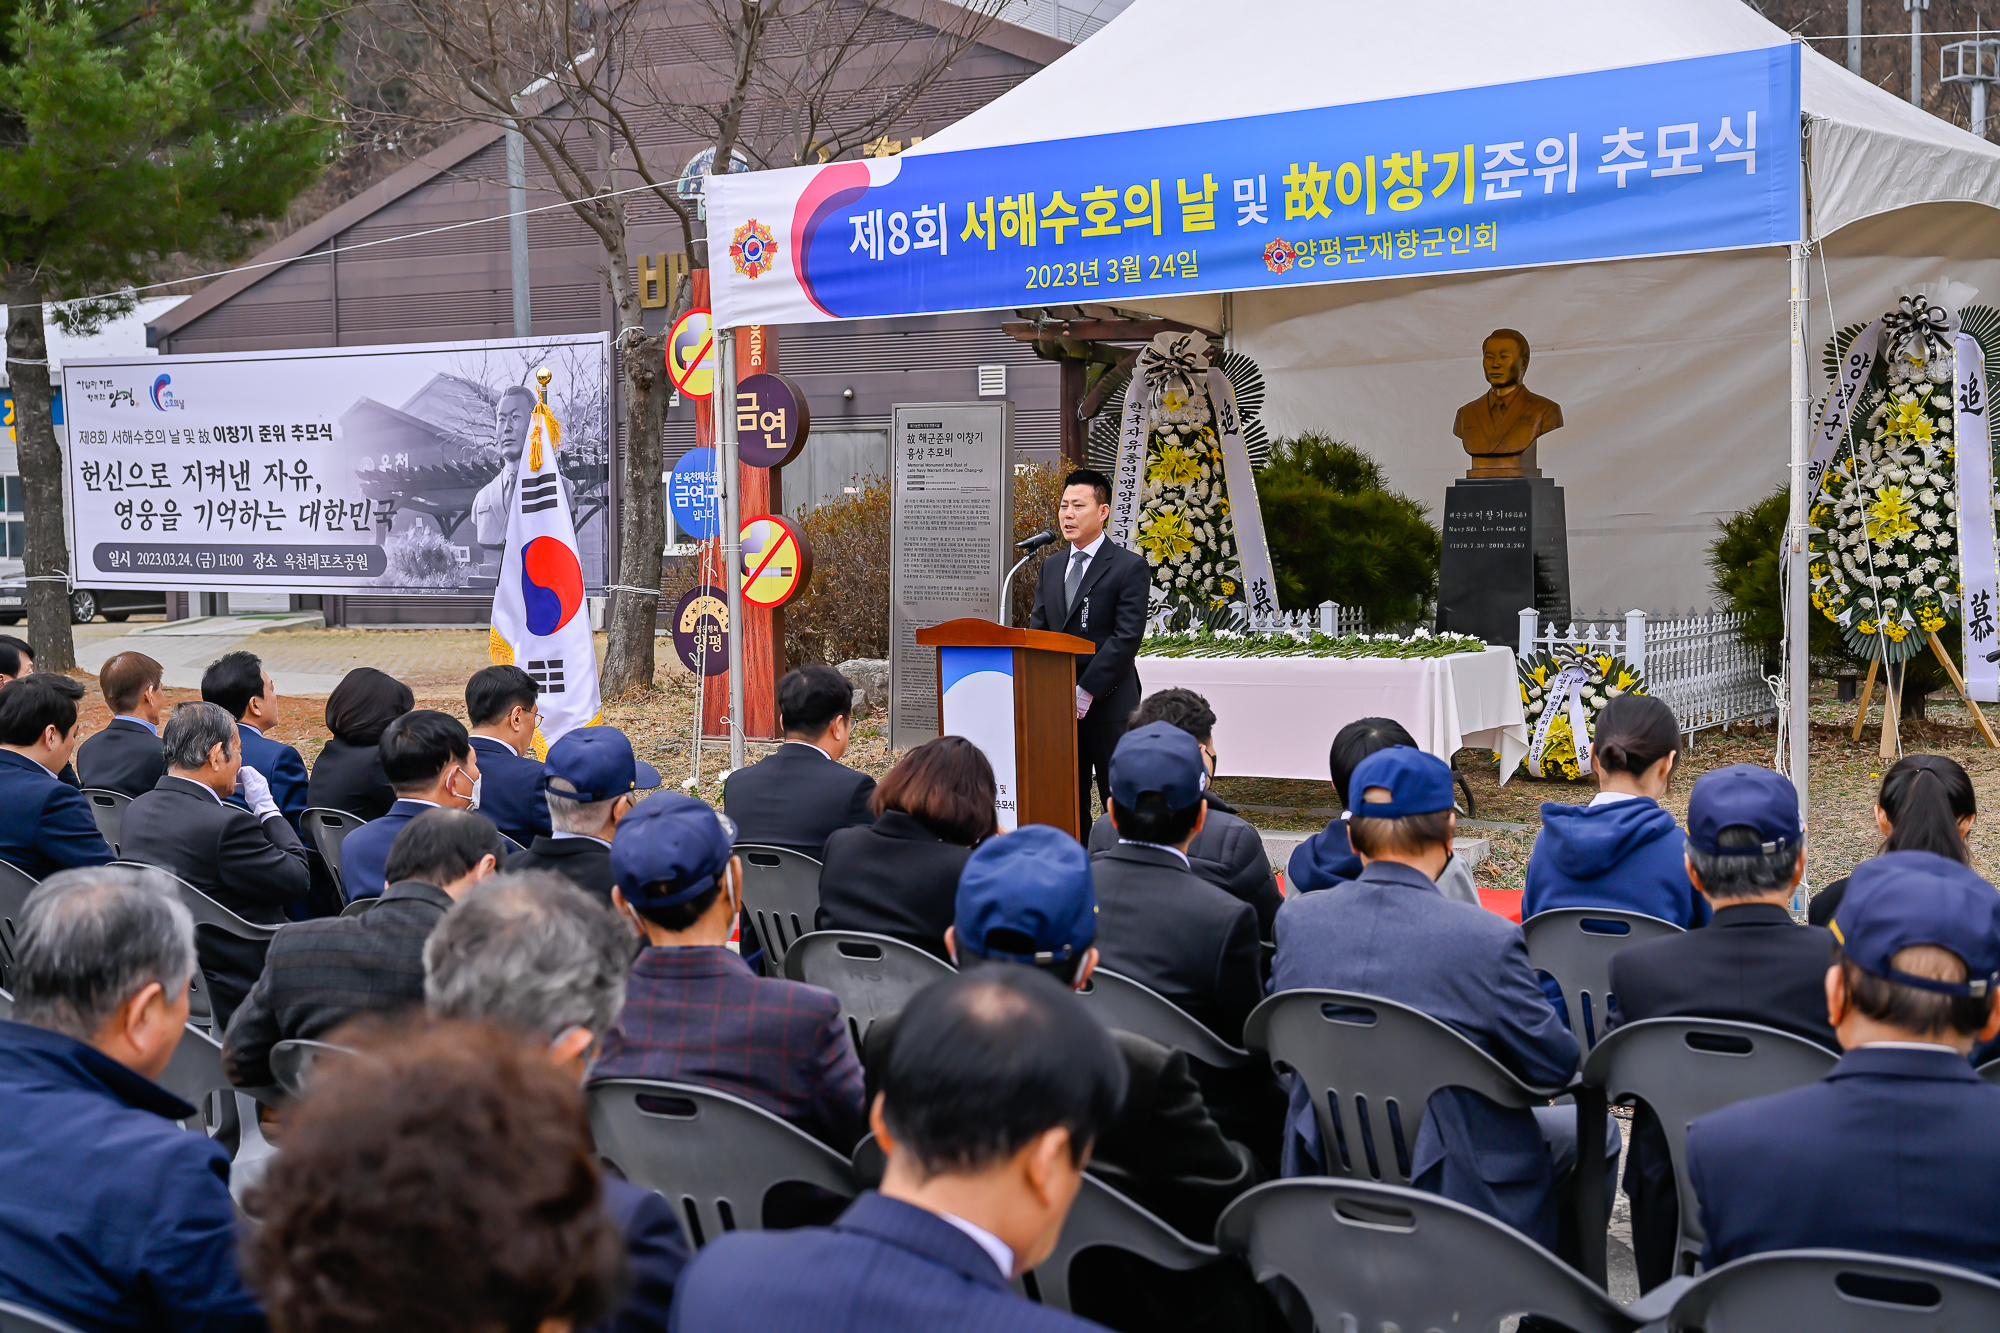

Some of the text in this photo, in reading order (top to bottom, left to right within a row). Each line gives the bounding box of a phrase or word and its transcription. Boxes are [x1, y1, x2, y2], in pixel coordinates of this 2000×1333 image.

[848, 201, 949, 261] 제8회
[959, 177, 1162, 251] 서해수호의
[1176, 171, 1220, 233] 날
[1233, 173, 1269, 227] 및
[1598, 109, 1758, 189] 추모식
[1294, 221, 1498, 270] 양평군재향군인회
[1024, 248, 1199, 290] 2023년 3월 24일
[79, 423, 334, 445] 제8회 서해수호의 날 및 故 이창기 준위 추모식
[737, 392, 787, 449] 금연
[918, 432, 953, 445] 해군준위
[956, 432, 983, 445] 이창기
[926, 447, 953, 458] 추모비
[80, 458, 323, 495] 헌신으로 지켜낸 자유,
[674, 473, 682, 483] 본
[114, 497, 400, 533] 영웅을 기억하는 대한민국
[1960, 371, 1995, 645] 追 慕
[108, 550, 369, 571] 일시 2023.03.24. (금) 11:00 장소 옥천레포츠공원
[999, 784, 1007, 795] 및
[995, 800, 1016, 812] 추모식
